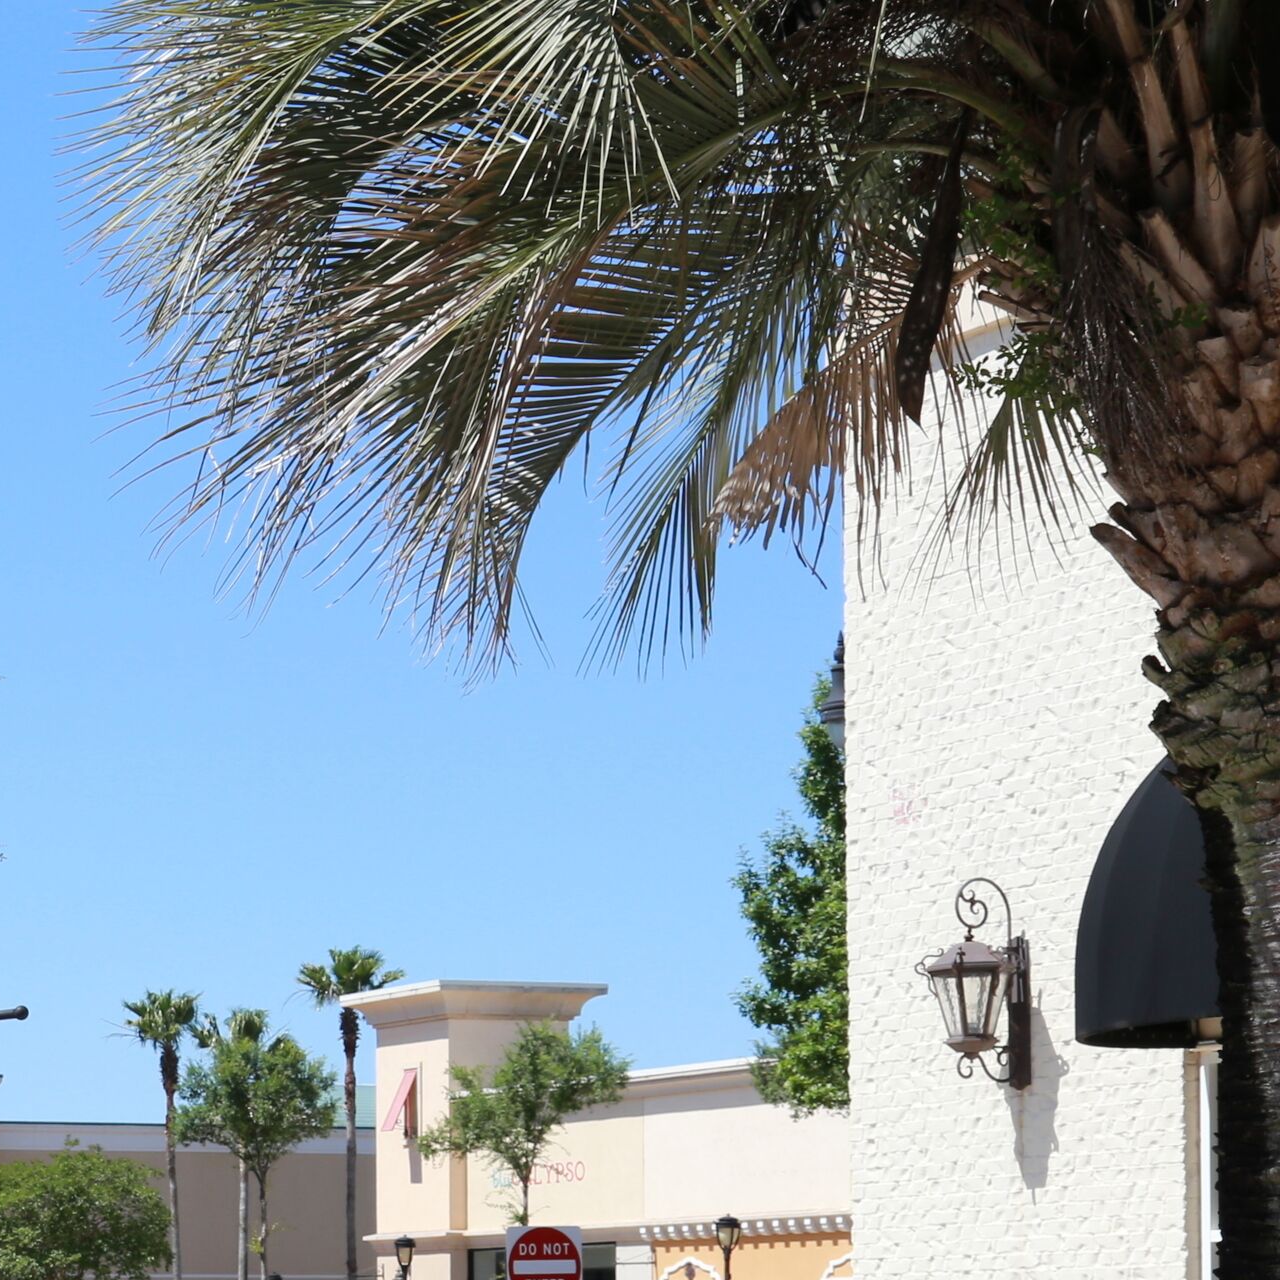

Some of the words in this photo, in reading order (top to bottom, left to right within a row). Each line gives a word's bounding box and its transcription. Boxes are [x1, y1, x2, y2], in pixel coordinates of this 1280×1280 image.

[511, 1160, 586, 1186] CLYPSO
[519, 1243, 537, 1256] DO
[543, 1242, 570, 1256] NOT
